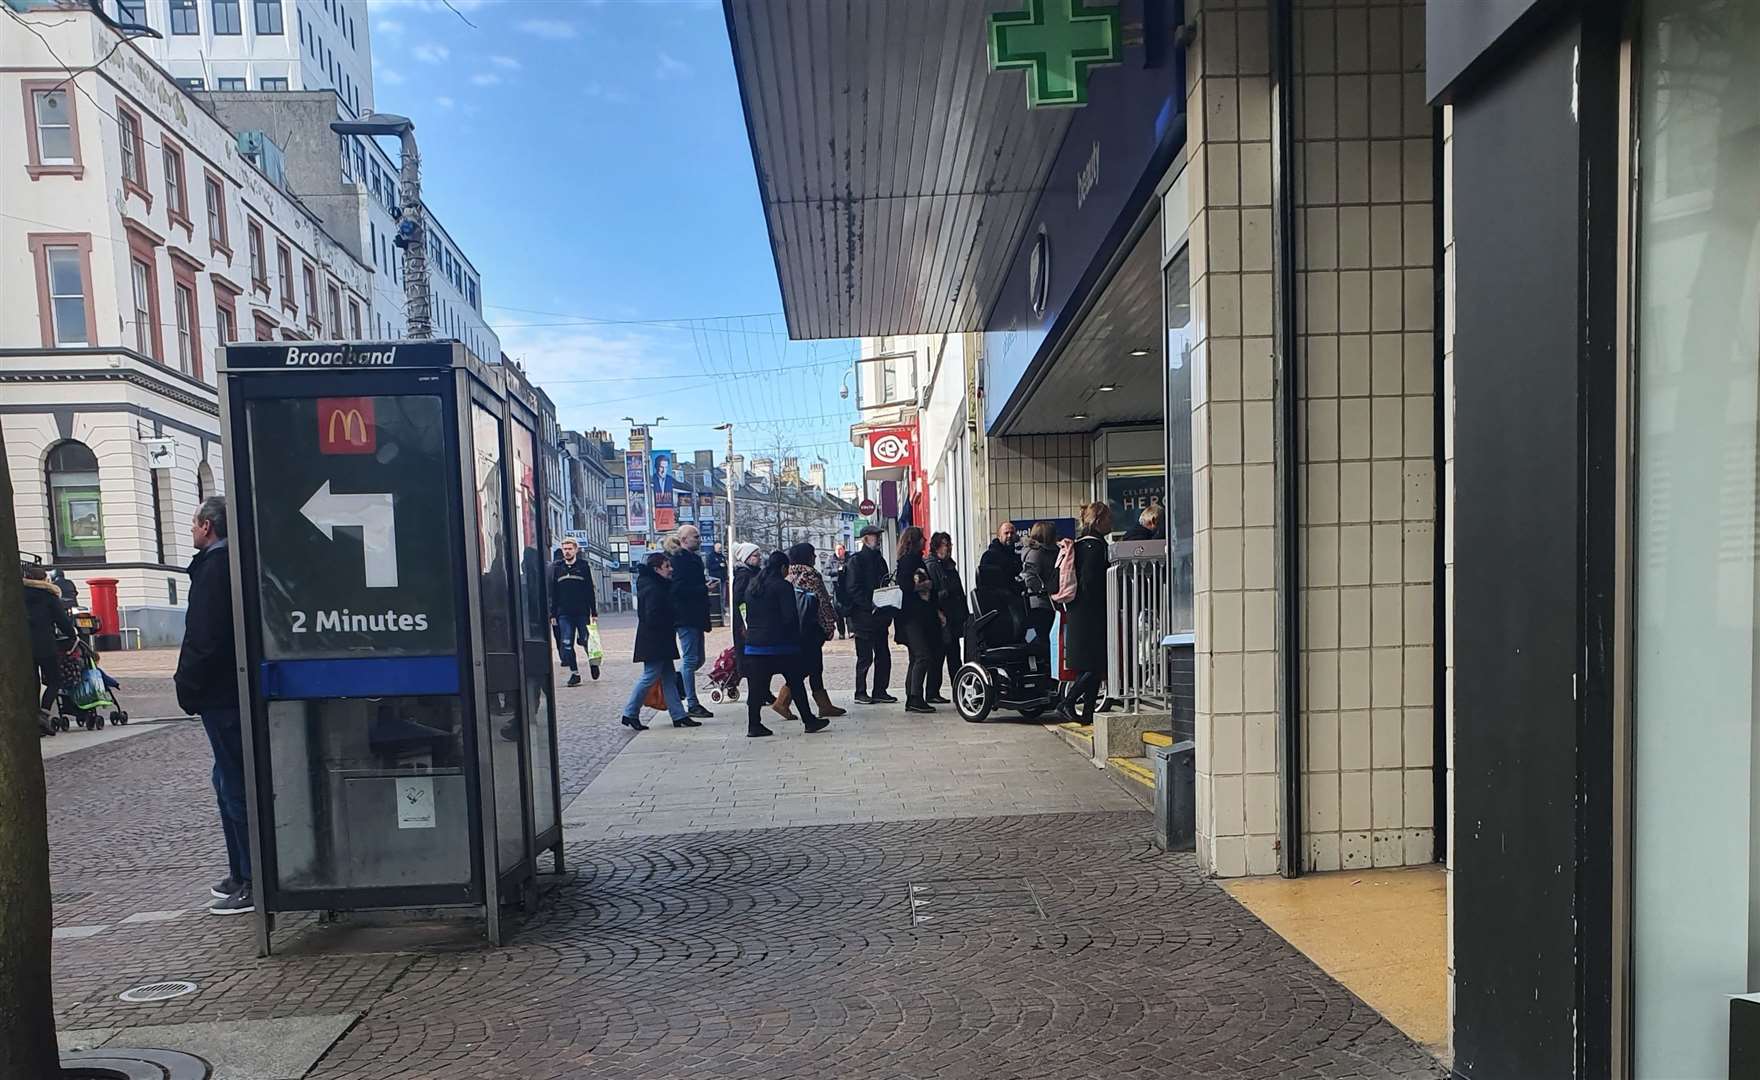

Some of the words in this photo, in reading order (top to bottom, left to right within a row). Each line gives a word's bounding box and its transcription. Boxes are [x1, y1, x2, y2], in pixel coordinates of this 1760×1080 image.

[286, 346, 397, 366] Broadband
[291, 610, 307, 633] 2
[315, 608, 429, 633] Minutes
